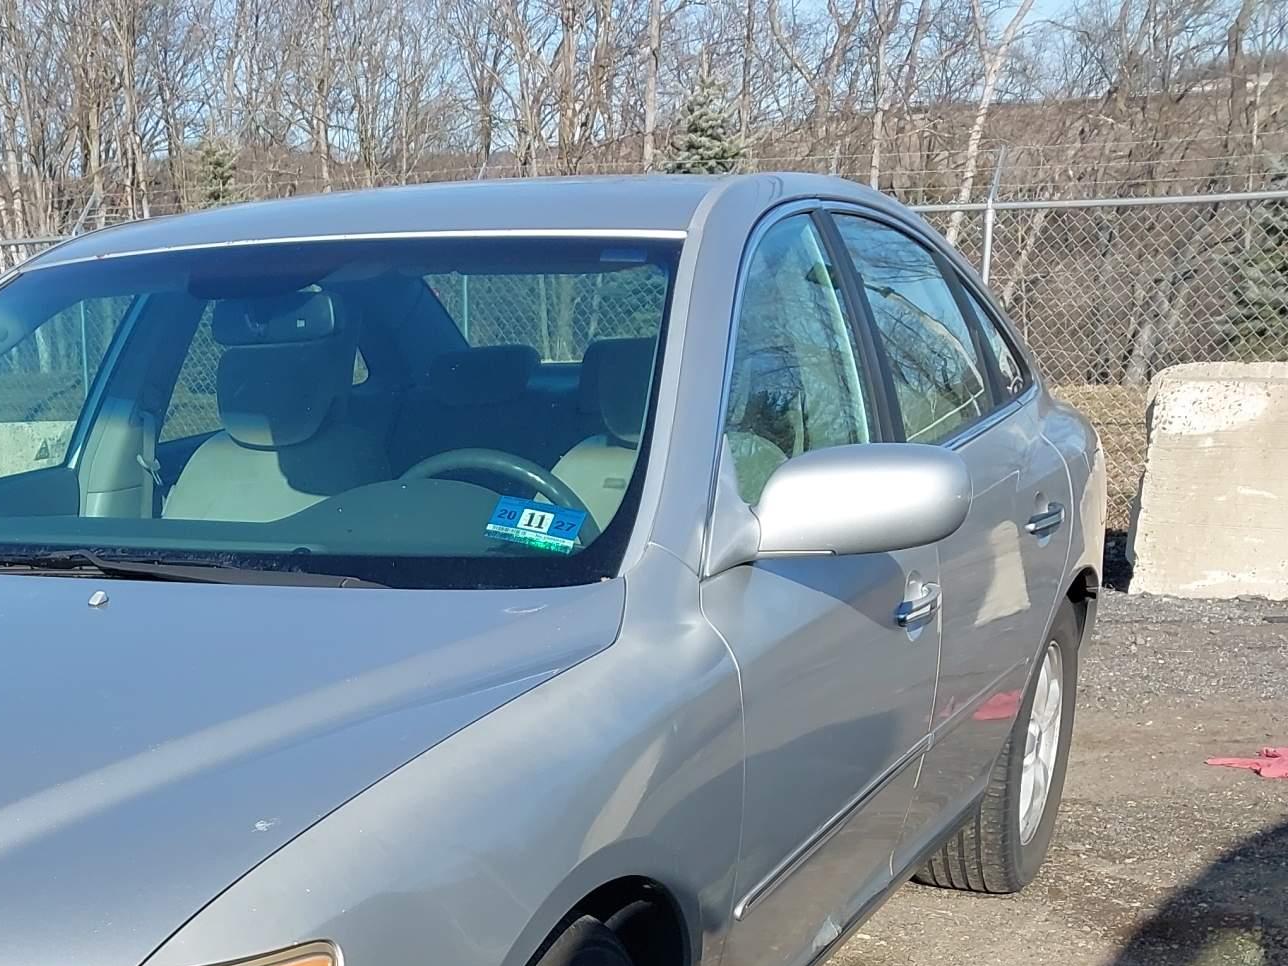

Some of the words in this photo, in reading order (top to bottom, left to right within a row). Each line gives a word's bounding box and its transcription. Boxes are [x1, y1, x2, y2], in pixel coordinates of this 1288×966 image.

[497, 508, 517, 521] 20
[523, 512, 546, 529] 11
[554, 520, 577, 532] 27
